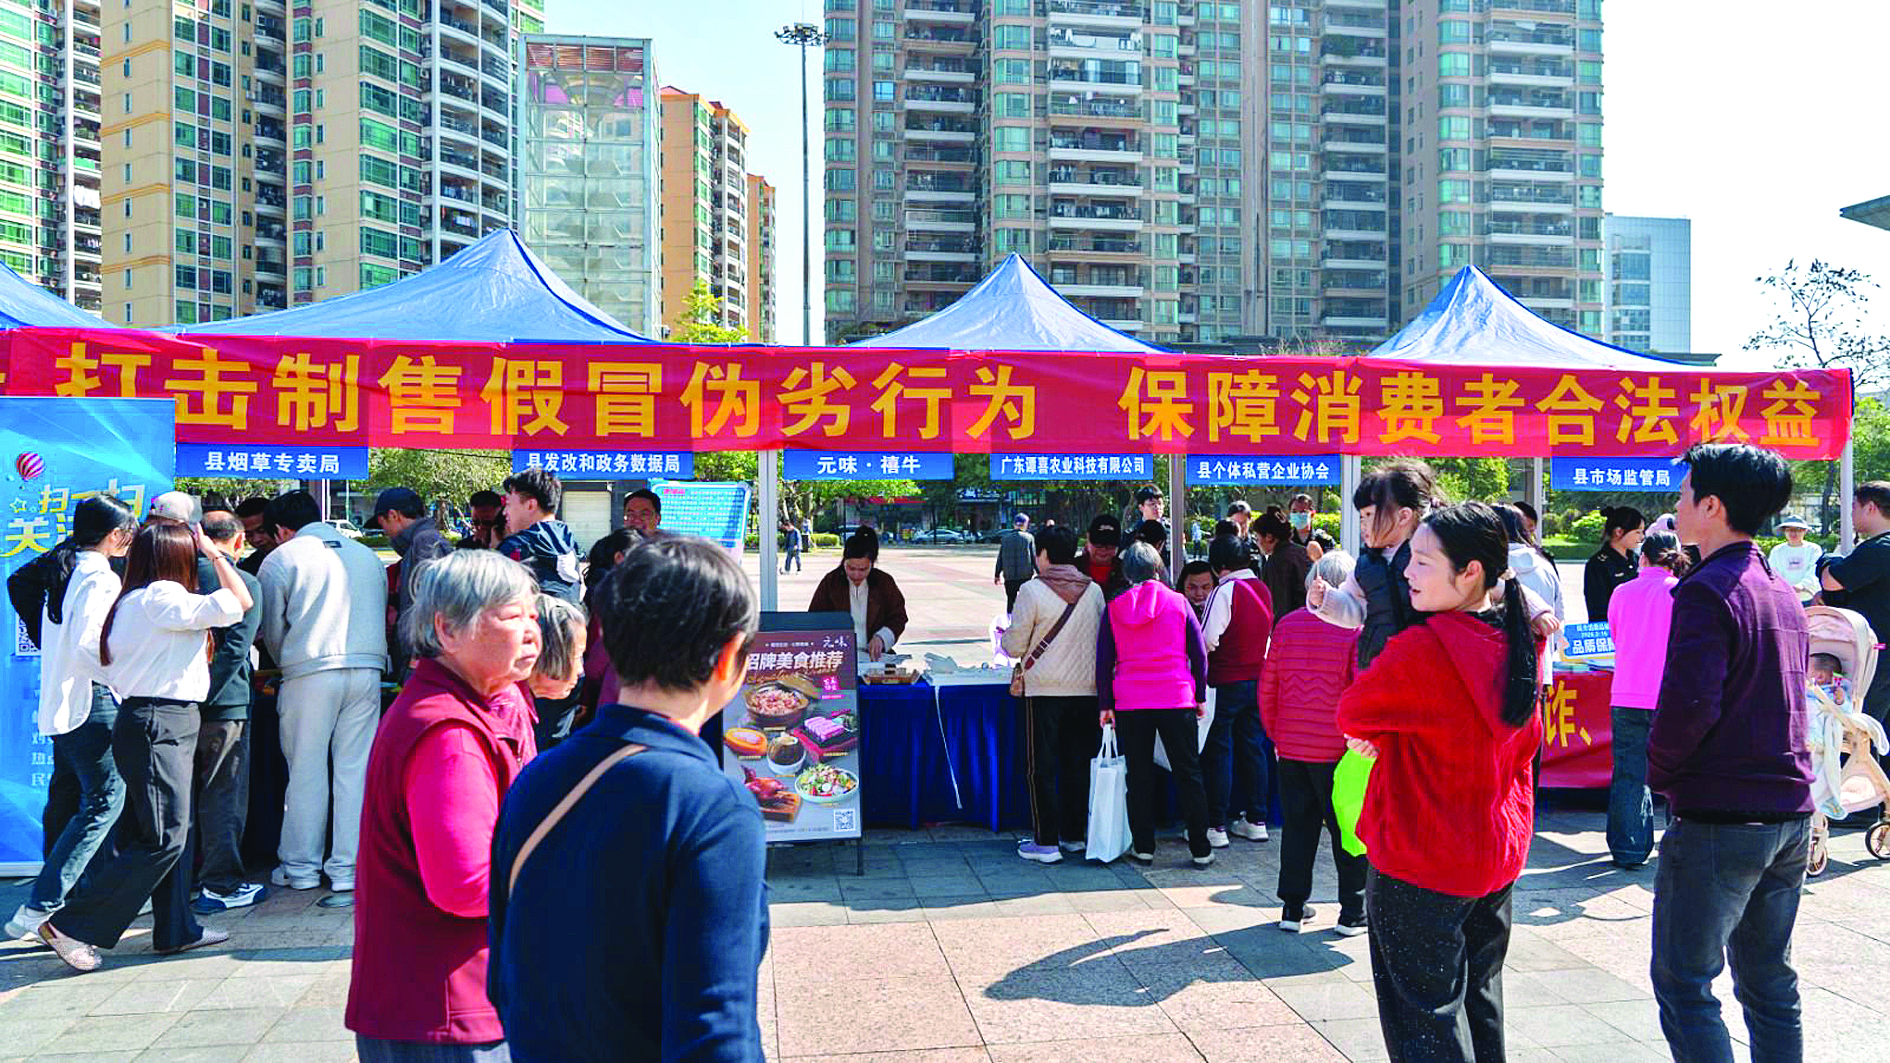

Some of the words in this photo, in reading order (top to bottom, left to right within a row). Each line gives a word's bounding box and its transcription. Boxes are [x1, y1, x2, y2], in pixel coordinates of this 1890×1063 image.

[55, 341, 1036, 440] 打击制售假冒伪劣行为
[1117, 366, 1820, 447] 保障消费者合法权益
[204, 451, 340, 474] 县烟草专卖局
[526, 452, 680, 473] 县发改和政务数据局
[1197, 460, 1330, 480] 县个体私营企业协会
[1573, 468, 1671, 487] 县市场监管局
